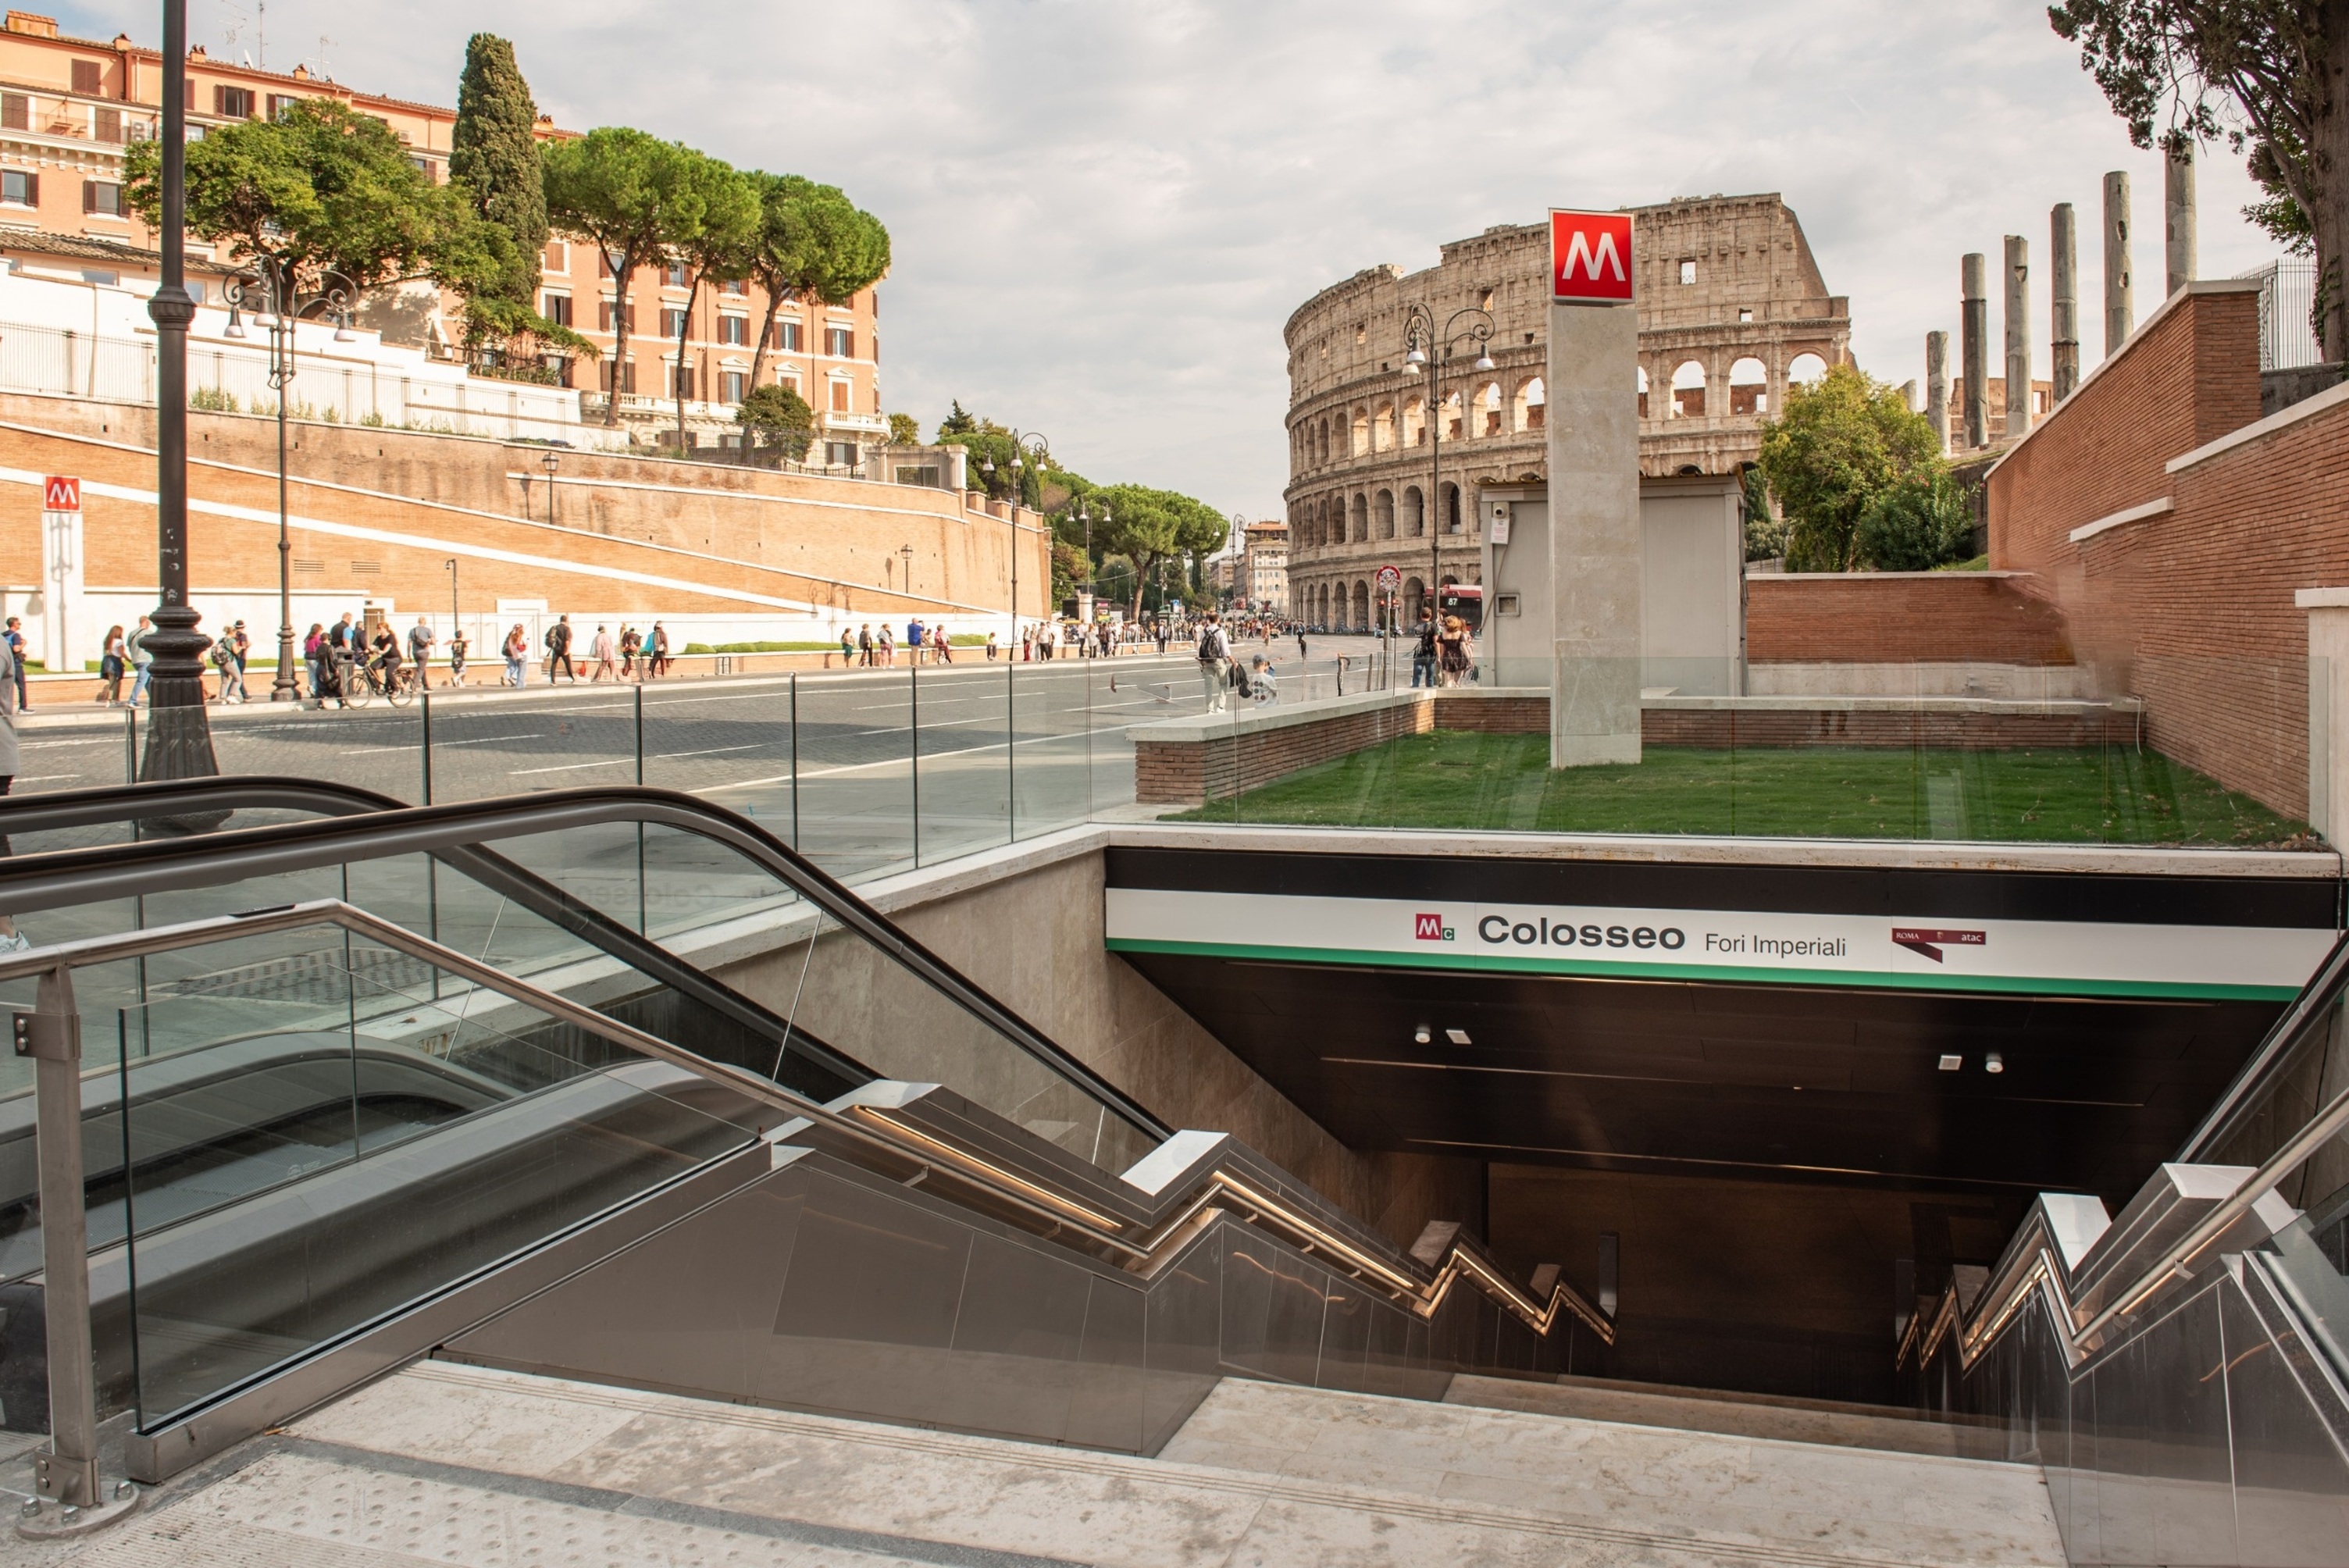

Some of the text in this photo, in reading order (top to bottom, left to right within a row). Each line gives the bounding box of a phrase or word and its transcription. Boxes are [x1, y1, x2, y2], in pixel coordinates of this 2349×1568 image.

[1562, 231, 1626, 281] M
[48, 483, 77, 504] M
[1448, 597, 1458, 606] 87
[1418, 918, 1440, 935] M
[1478, 915, 1845, 959] Colosseo Fori Imperiali
